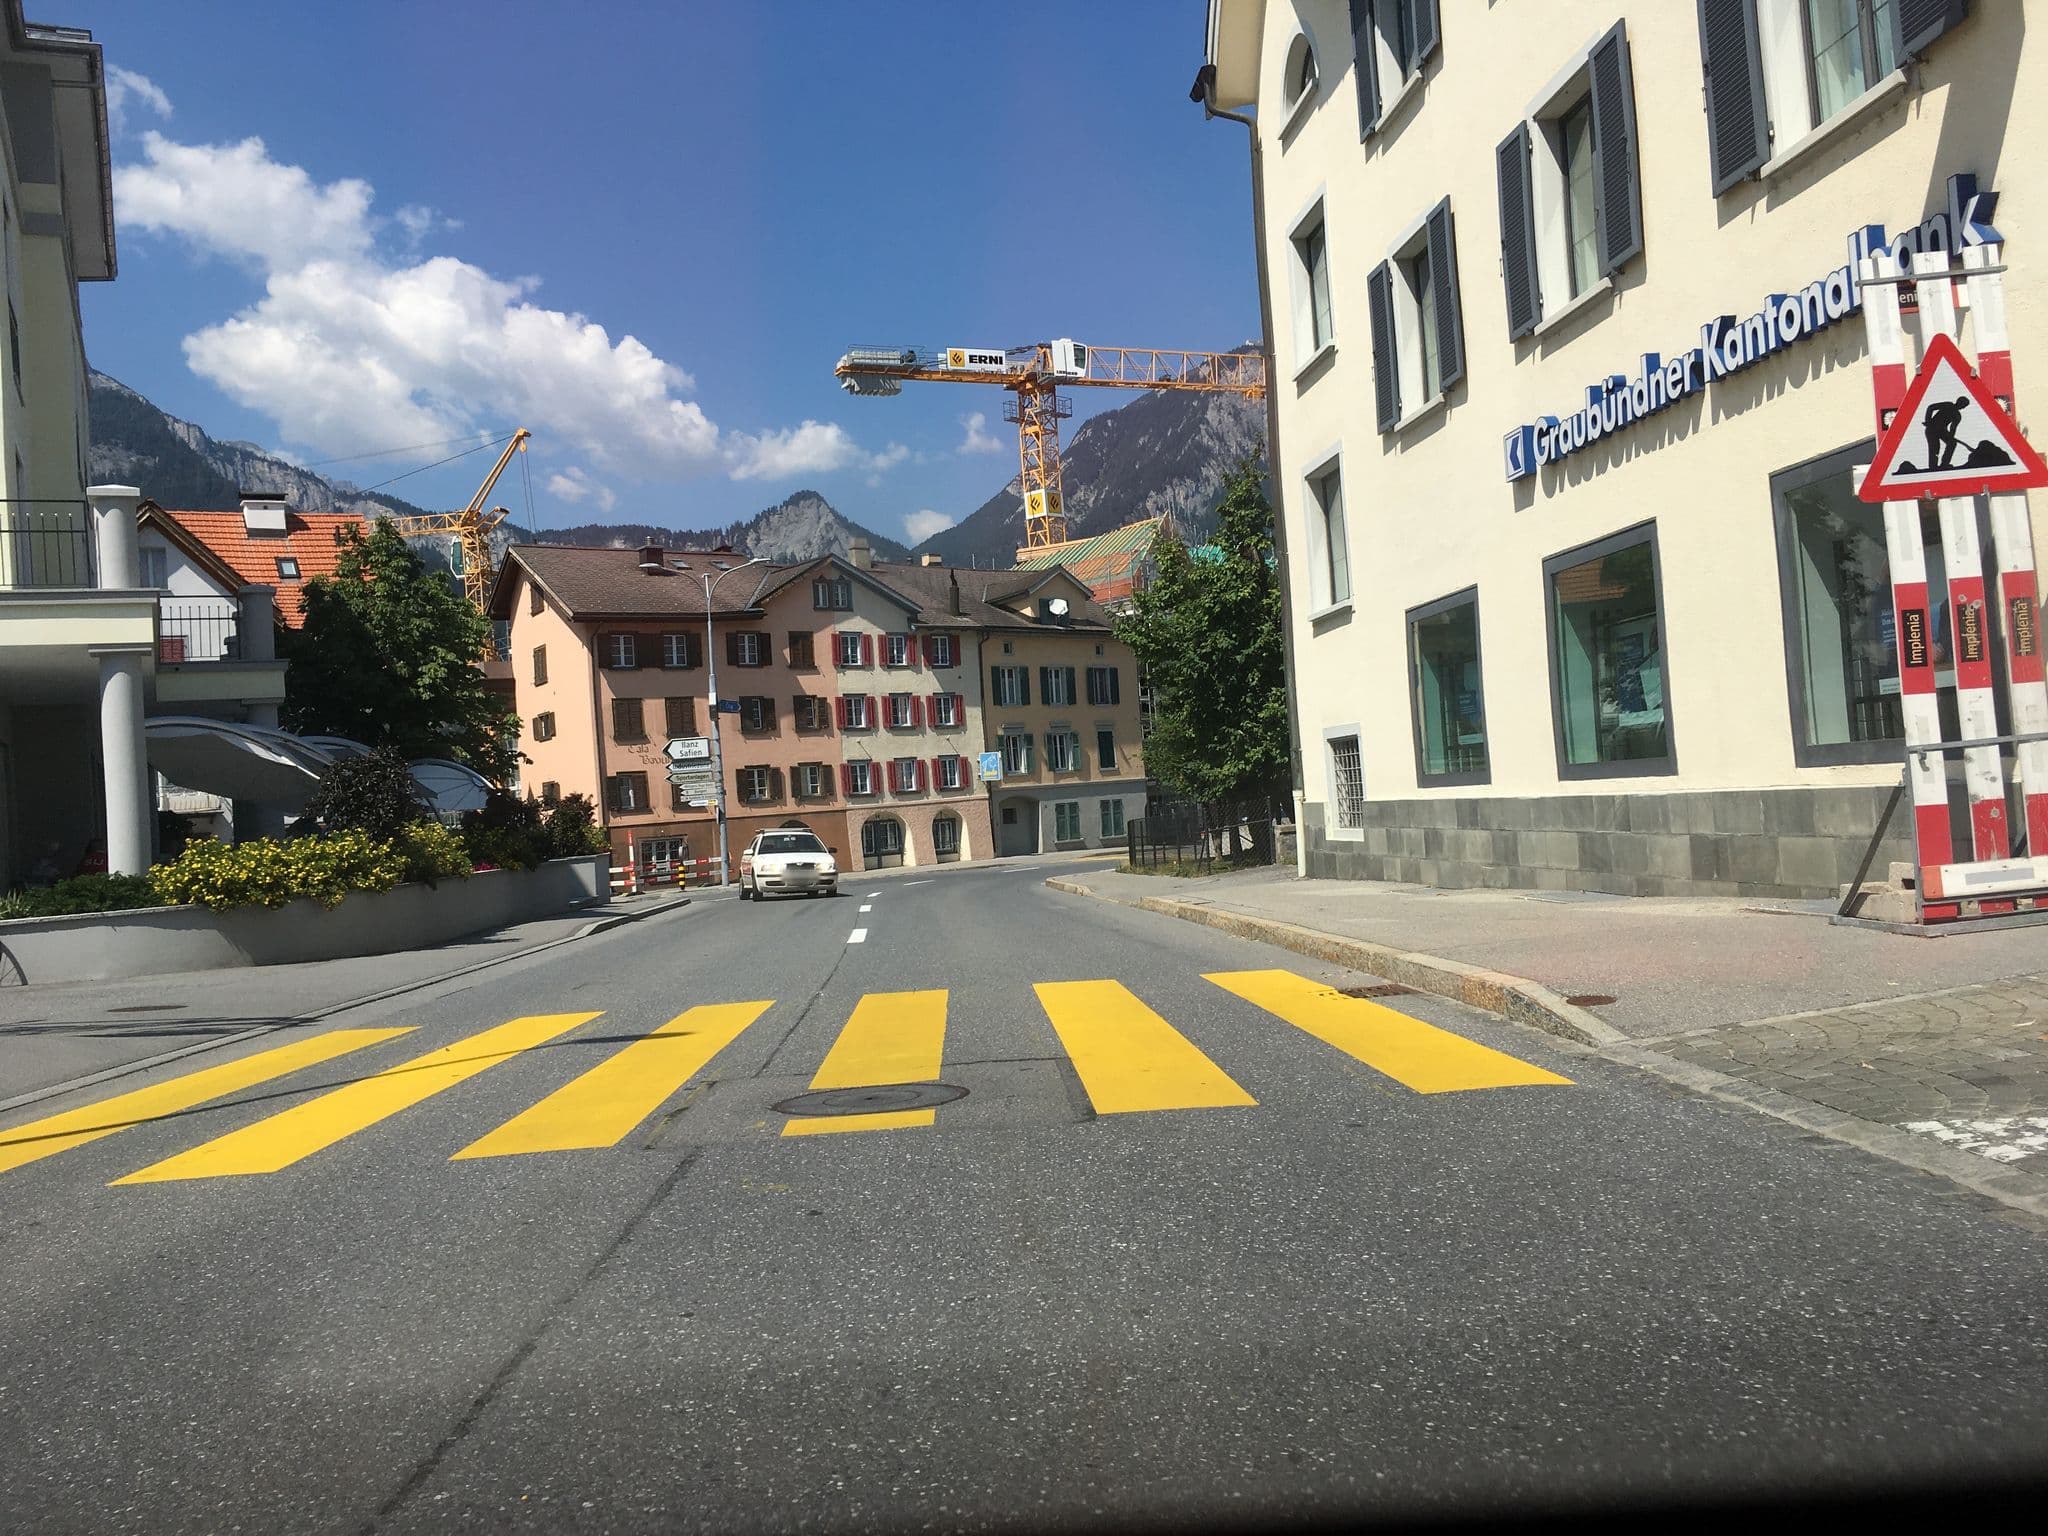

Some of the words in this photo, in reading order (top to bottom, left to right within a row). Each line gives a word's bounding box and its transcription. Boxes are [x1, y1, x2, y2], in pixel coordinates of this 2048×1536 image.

[968, 354, 1004, 366] ERNI
[1532, 353, 1697, 466] Graubündner
[1908, 614, 1925, 664] Implenia
[1962, 608, 1980, 660] Implenia
[2017, 602, 2033, 652] Implenia
[679, 749, 703, 758] Safien
[681, 741, 699, 749] Ilanz
